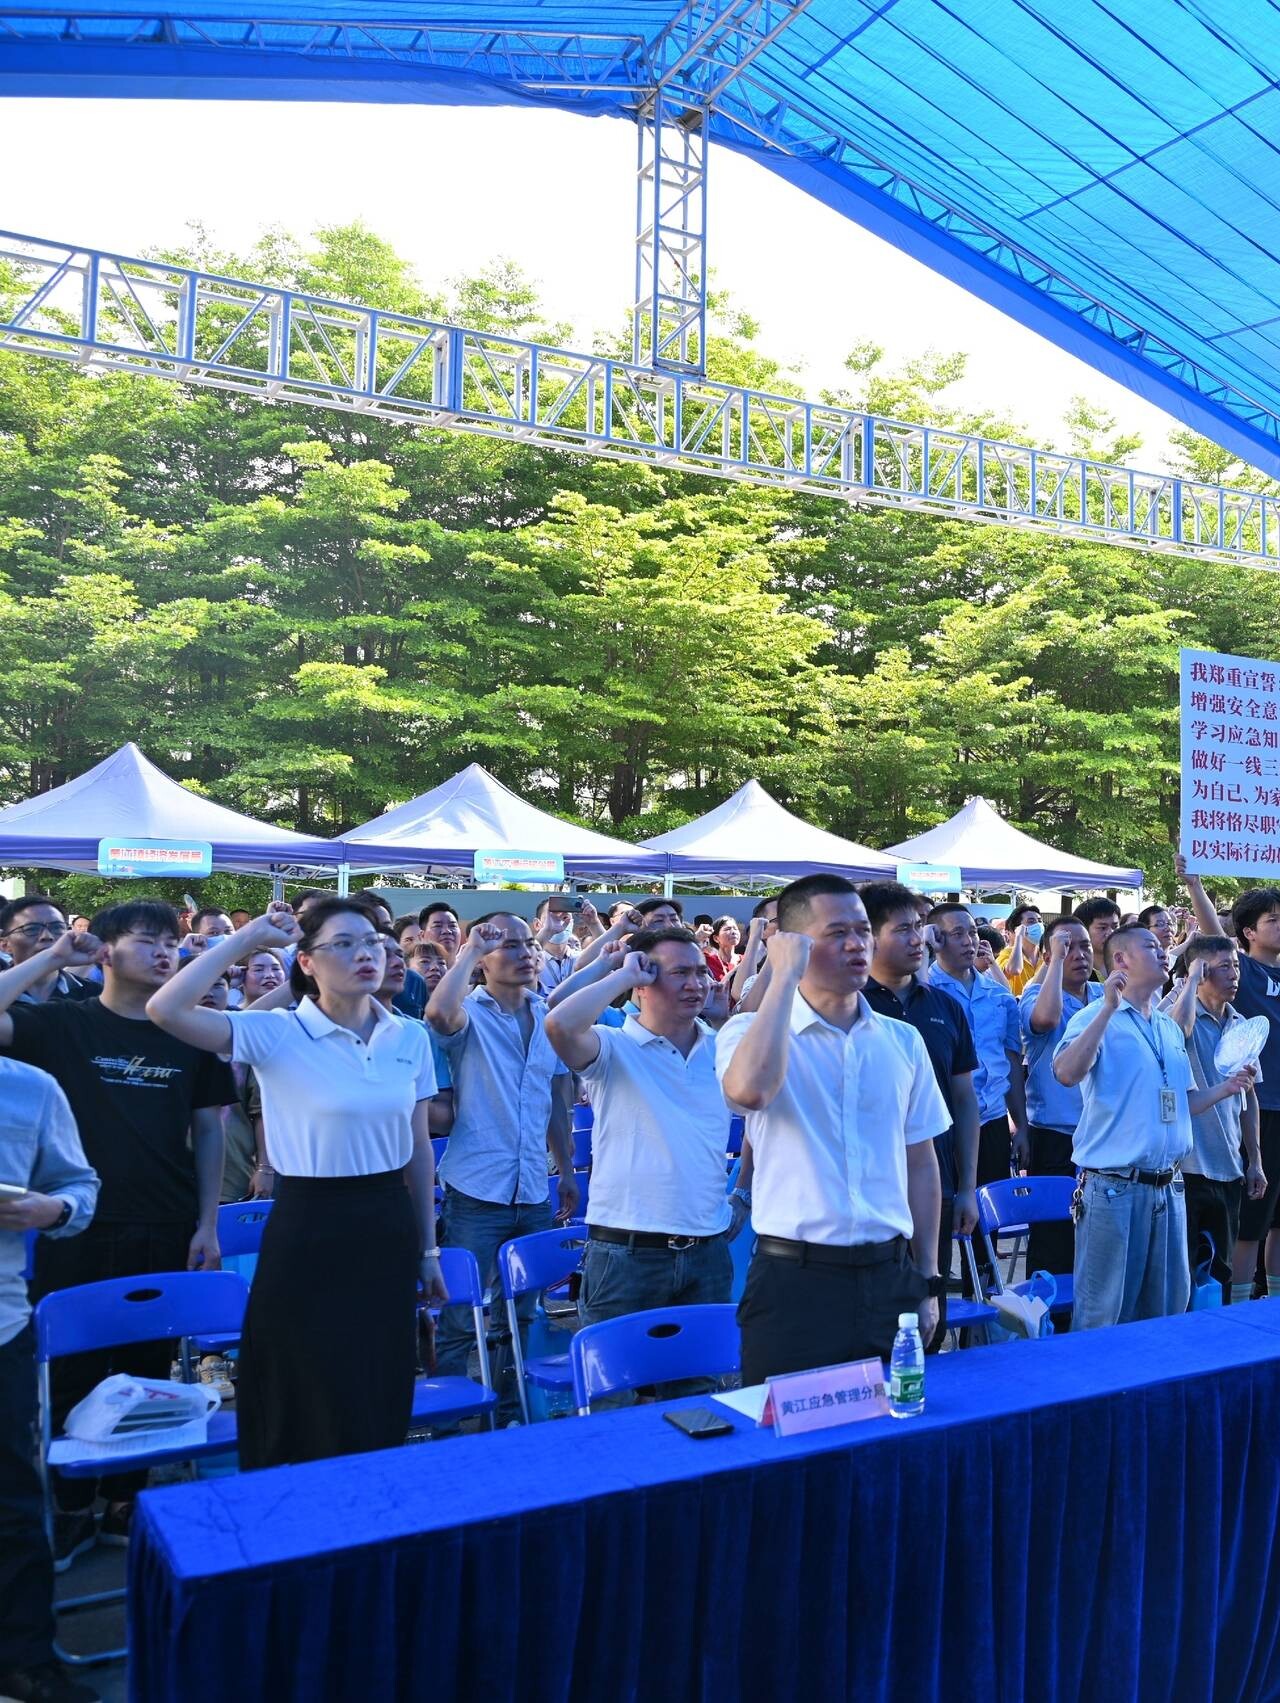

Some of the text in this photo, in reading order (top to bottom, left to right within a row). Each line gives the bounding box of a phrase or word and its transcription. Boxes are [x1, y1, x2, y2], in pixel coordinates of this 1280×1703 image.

[780, 1382, 888, 1416] 黄江应急管理分局
